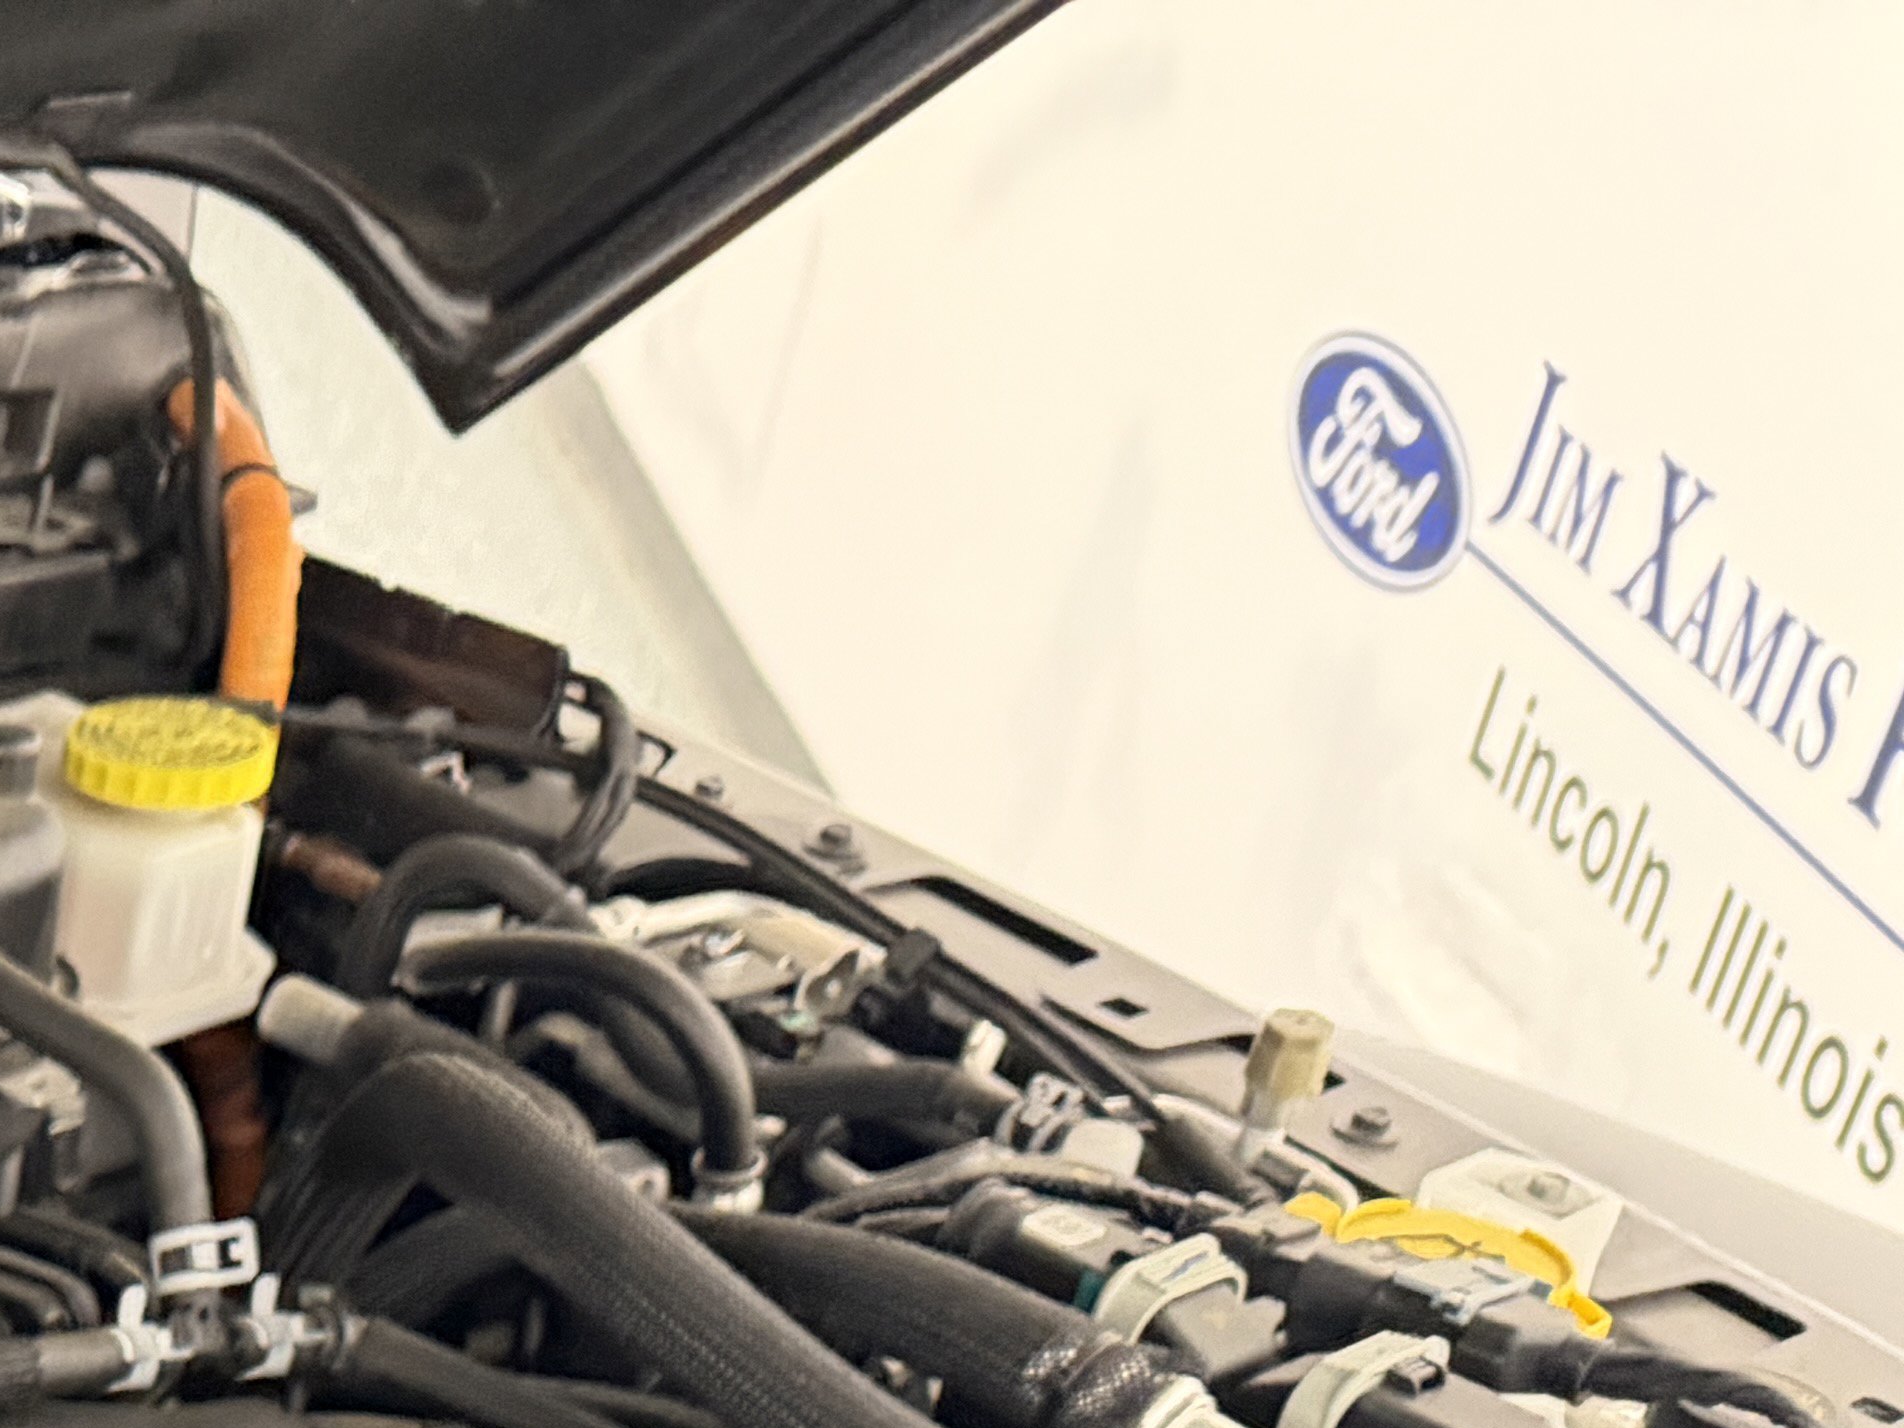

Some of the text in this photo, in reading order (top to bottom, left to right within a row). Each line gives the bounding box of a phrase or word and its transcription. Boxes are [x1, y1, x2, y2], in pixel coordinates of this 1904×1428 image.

[1309, 366, 1440, 562] Ford
[1487, 359, 1625, 576] JIM
[1610, 449, 1860, 771] XAMIS
[1468, 665, 1673, 981] Lincoln,
[1688, 882, 1904, 1184] Illinois
